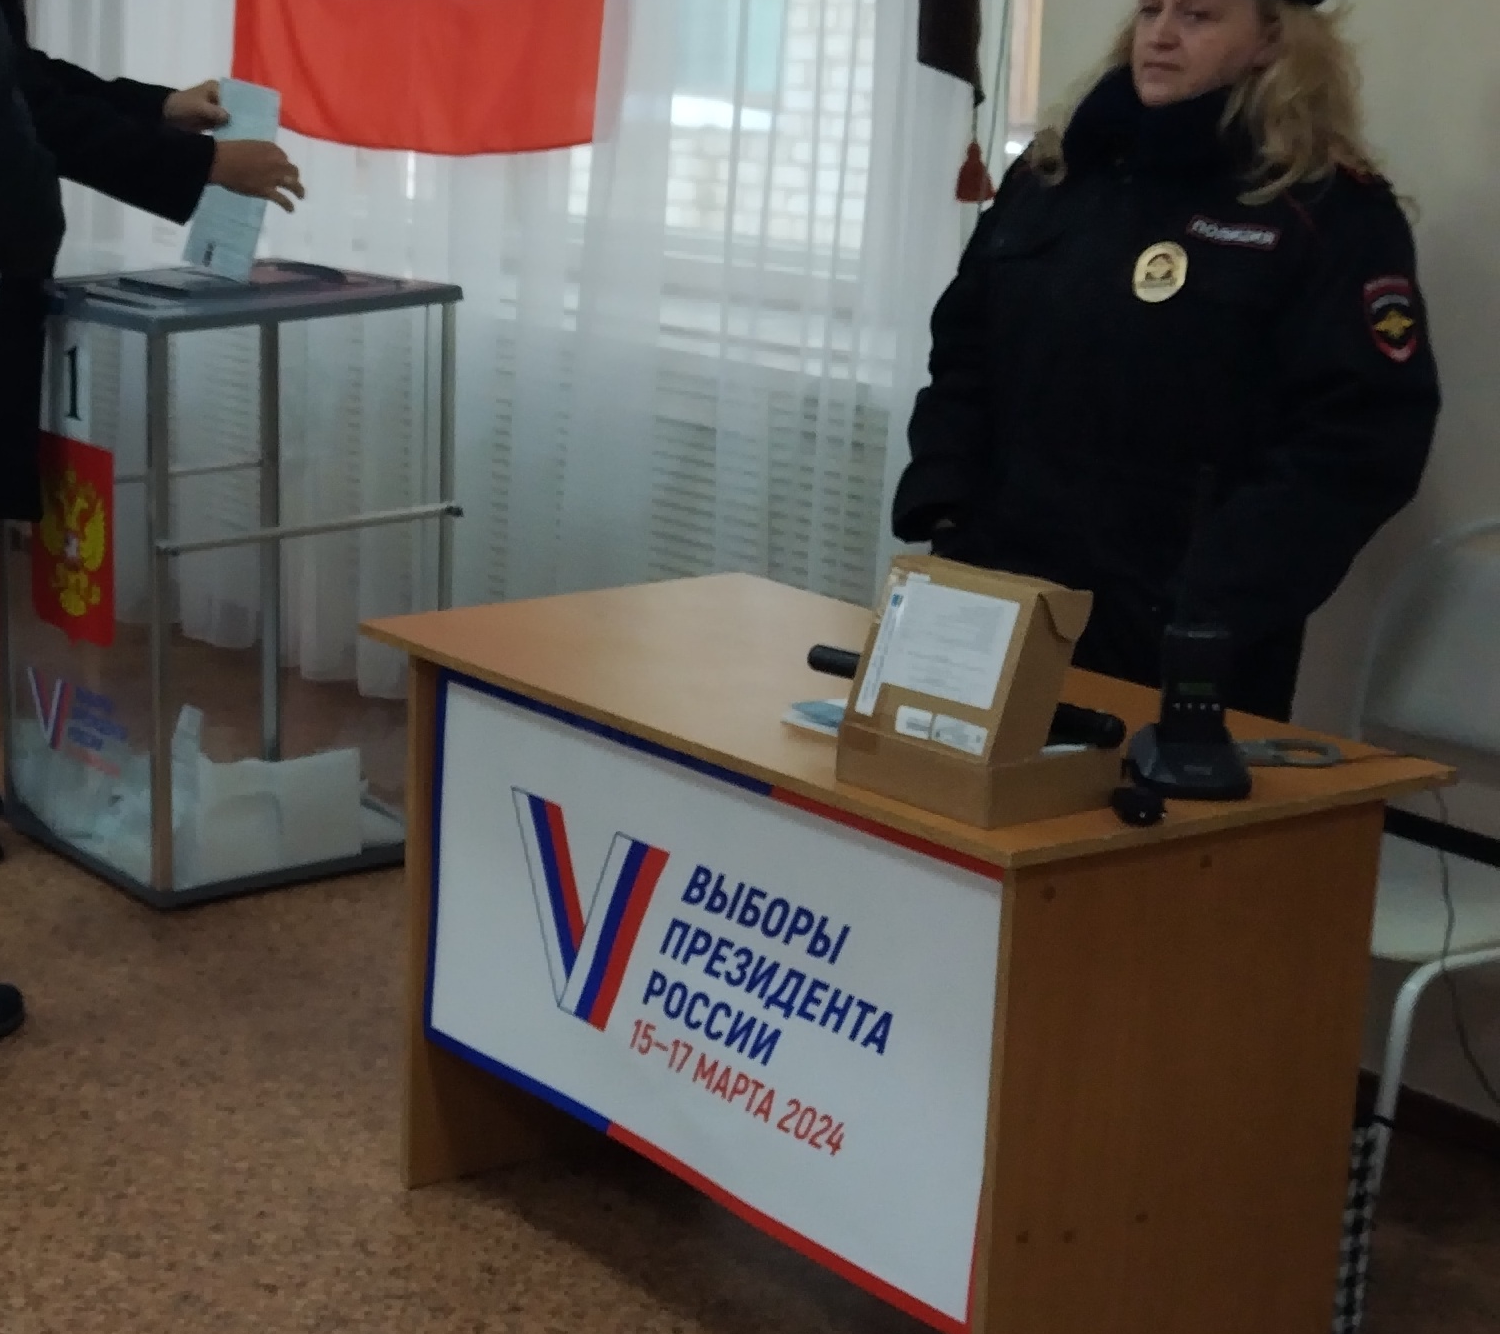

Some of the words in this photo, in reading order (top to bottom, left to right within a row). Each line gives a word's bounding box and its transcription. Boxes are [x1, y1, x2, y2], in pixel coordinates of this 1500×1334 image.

[681, 864, 851, 965] ВЫБОРЫ
[642, 969, 783, 1066] РОССИИ
[659, 917, 894, 1055] ПРЕЗИДЕНТА
[691, 1053, 776, 1124] МАРТА
[776, 1097, 846, 1156] 2024
